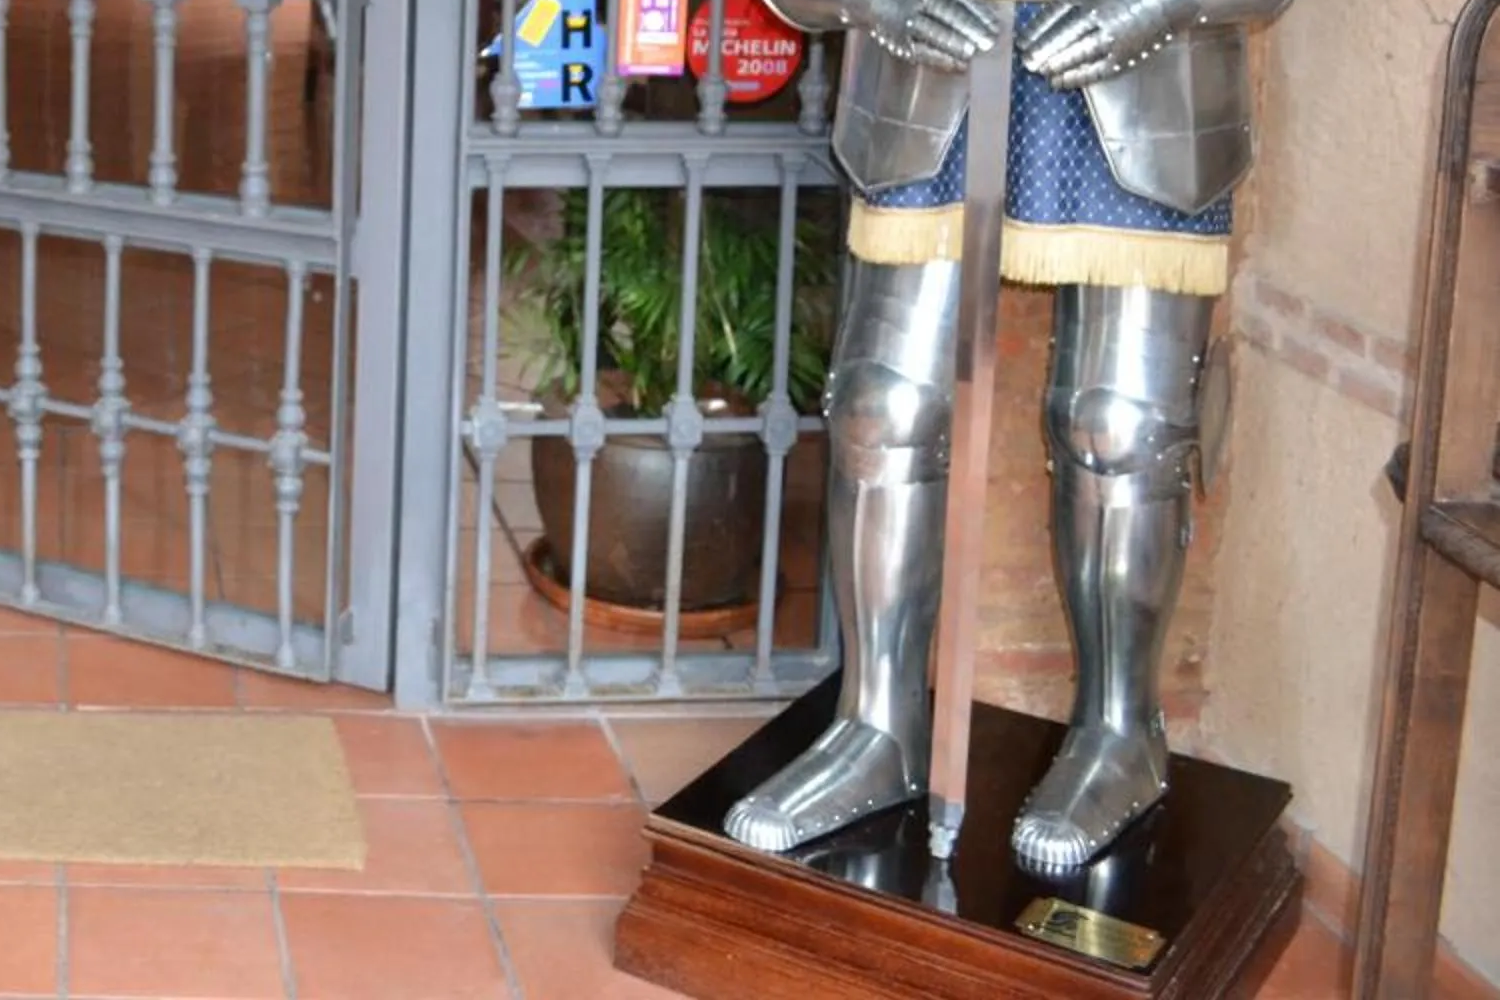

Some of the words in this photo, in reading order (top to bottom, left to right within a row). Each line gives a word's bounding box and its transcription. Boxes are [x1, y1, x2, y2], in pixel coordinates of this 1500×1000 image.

[561, 10, 592, 48] H
[692, 39, 796, 57] MCHELIN
[561, 63, 593, 102] R
